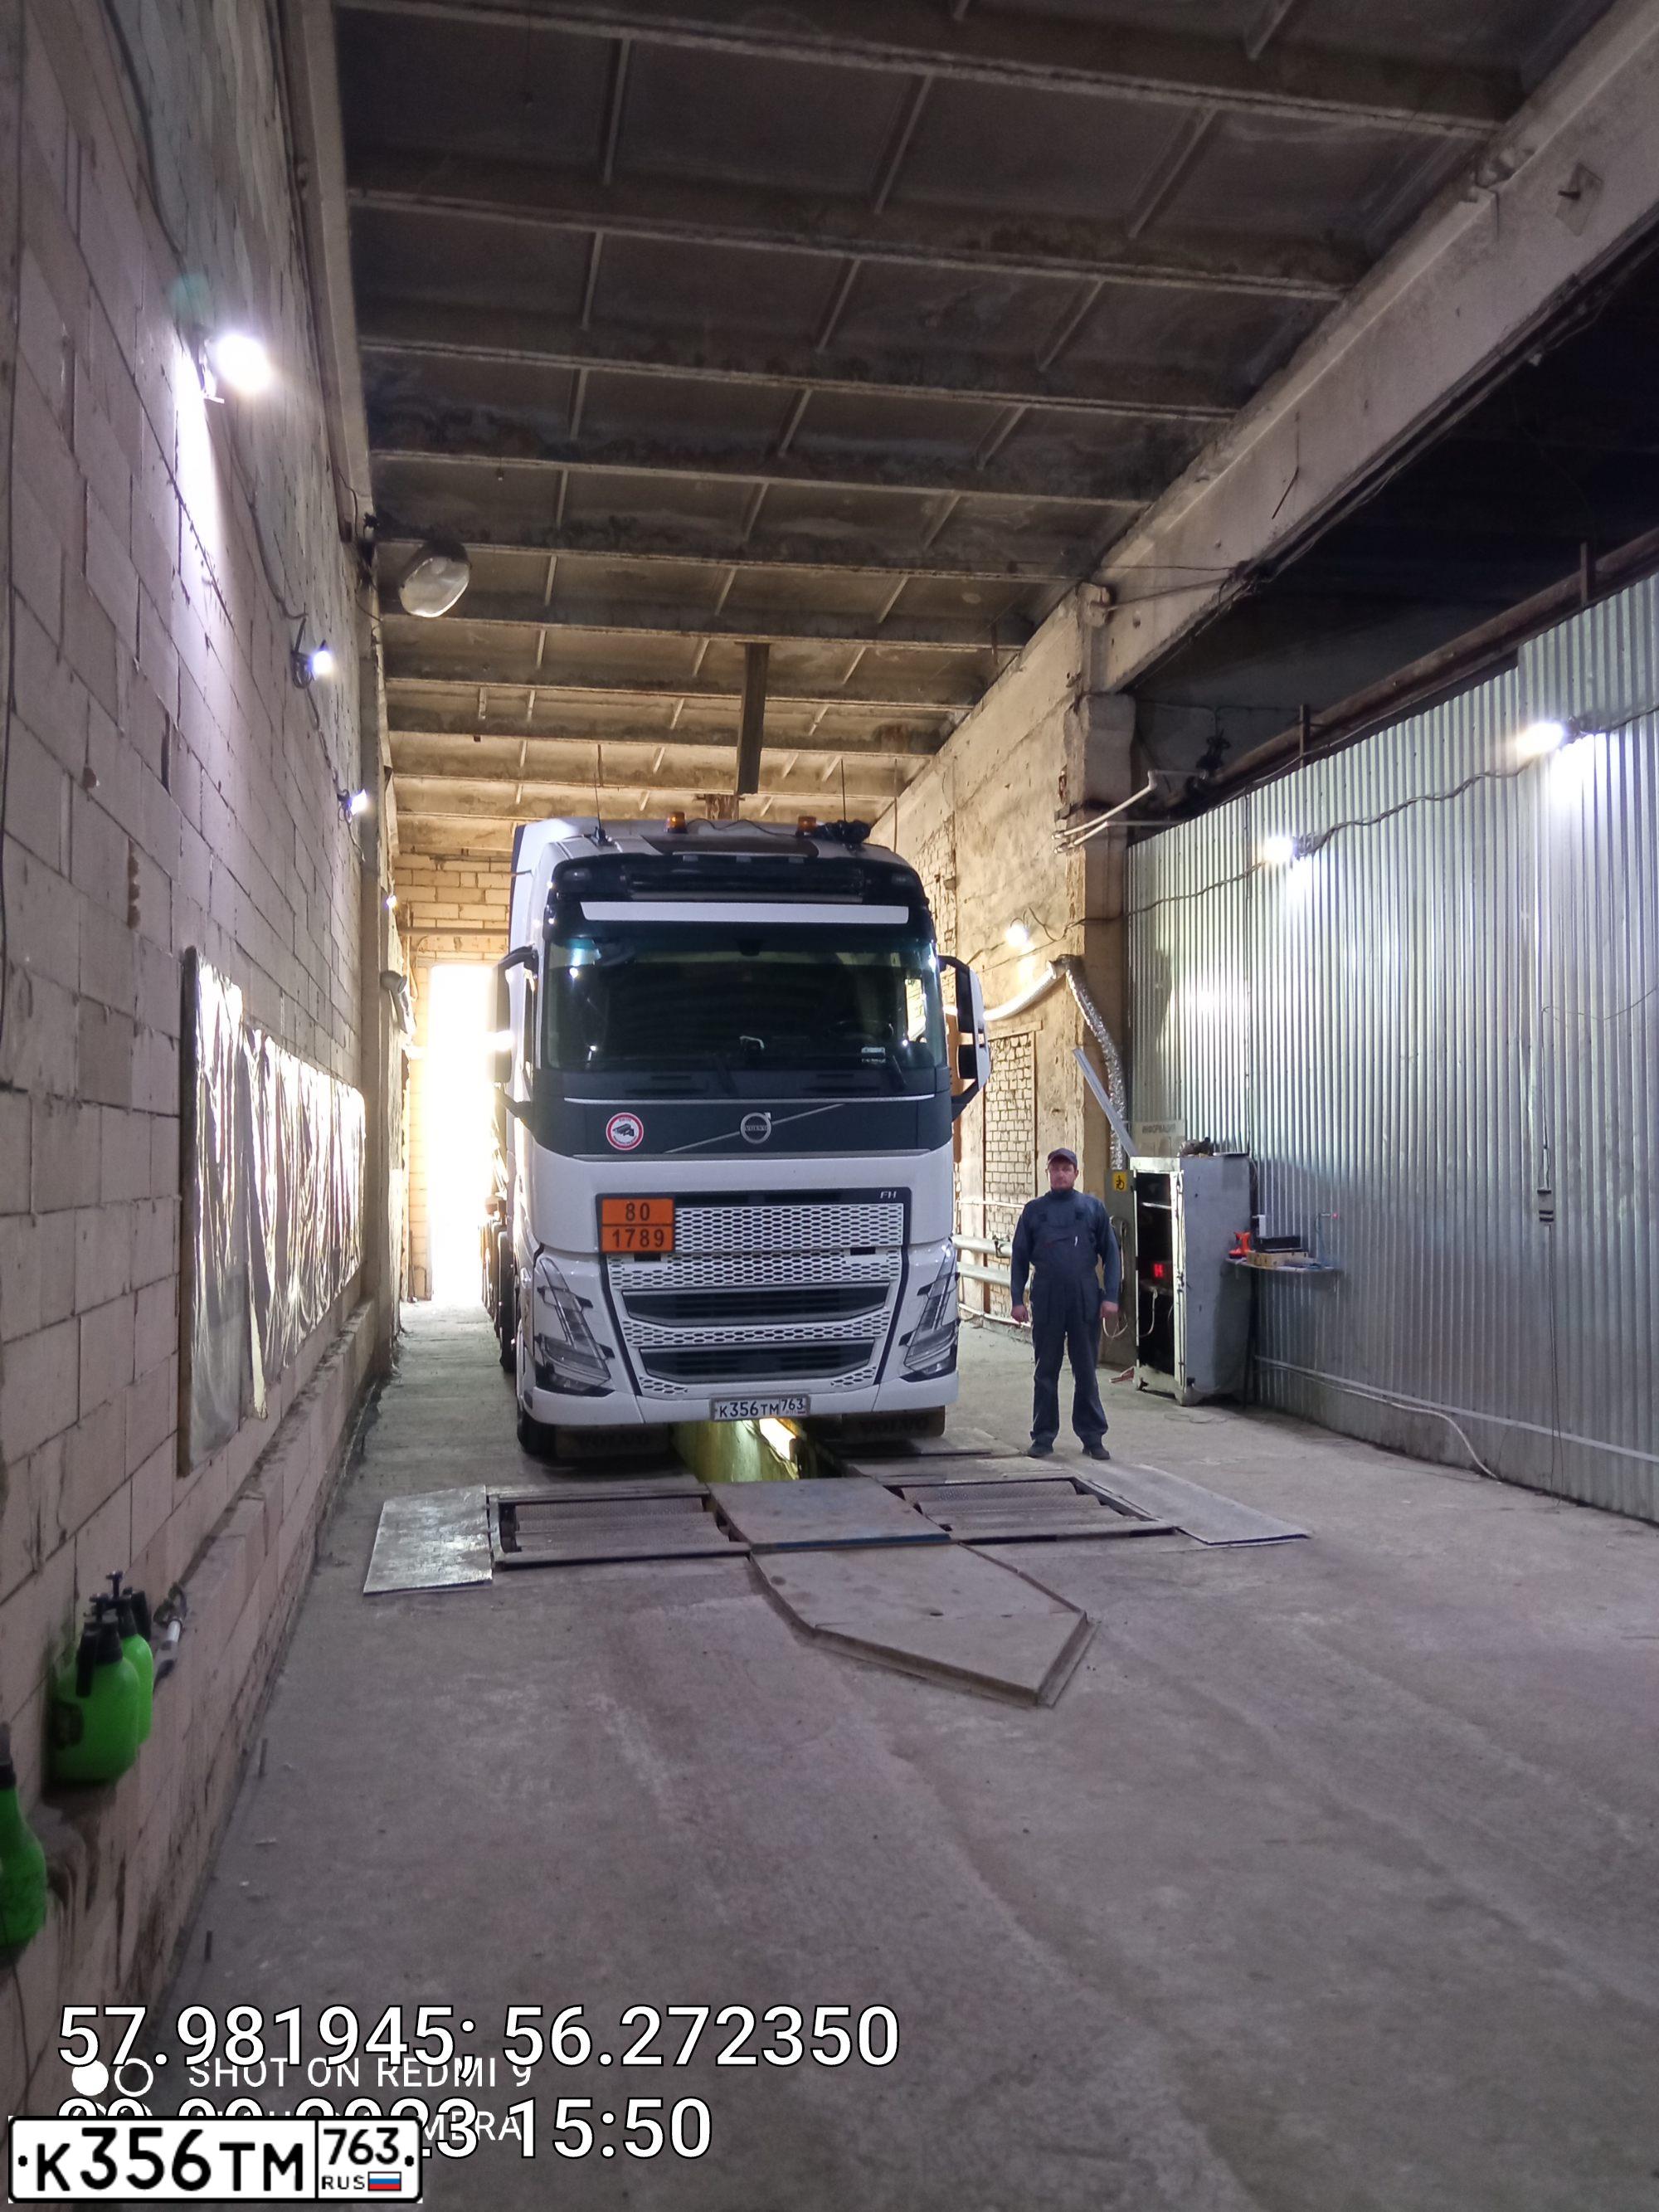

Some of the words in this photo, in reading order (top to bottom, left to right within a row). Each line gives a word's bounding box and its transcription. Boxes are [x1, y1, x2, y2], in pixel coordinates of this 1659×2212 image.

[880, 1191, 897, 1199] FH
[625, 1201, 650, 1222] 80
[612, 1228, 664, 1248] 1789
[781, 1397, 803, 1411] 763
